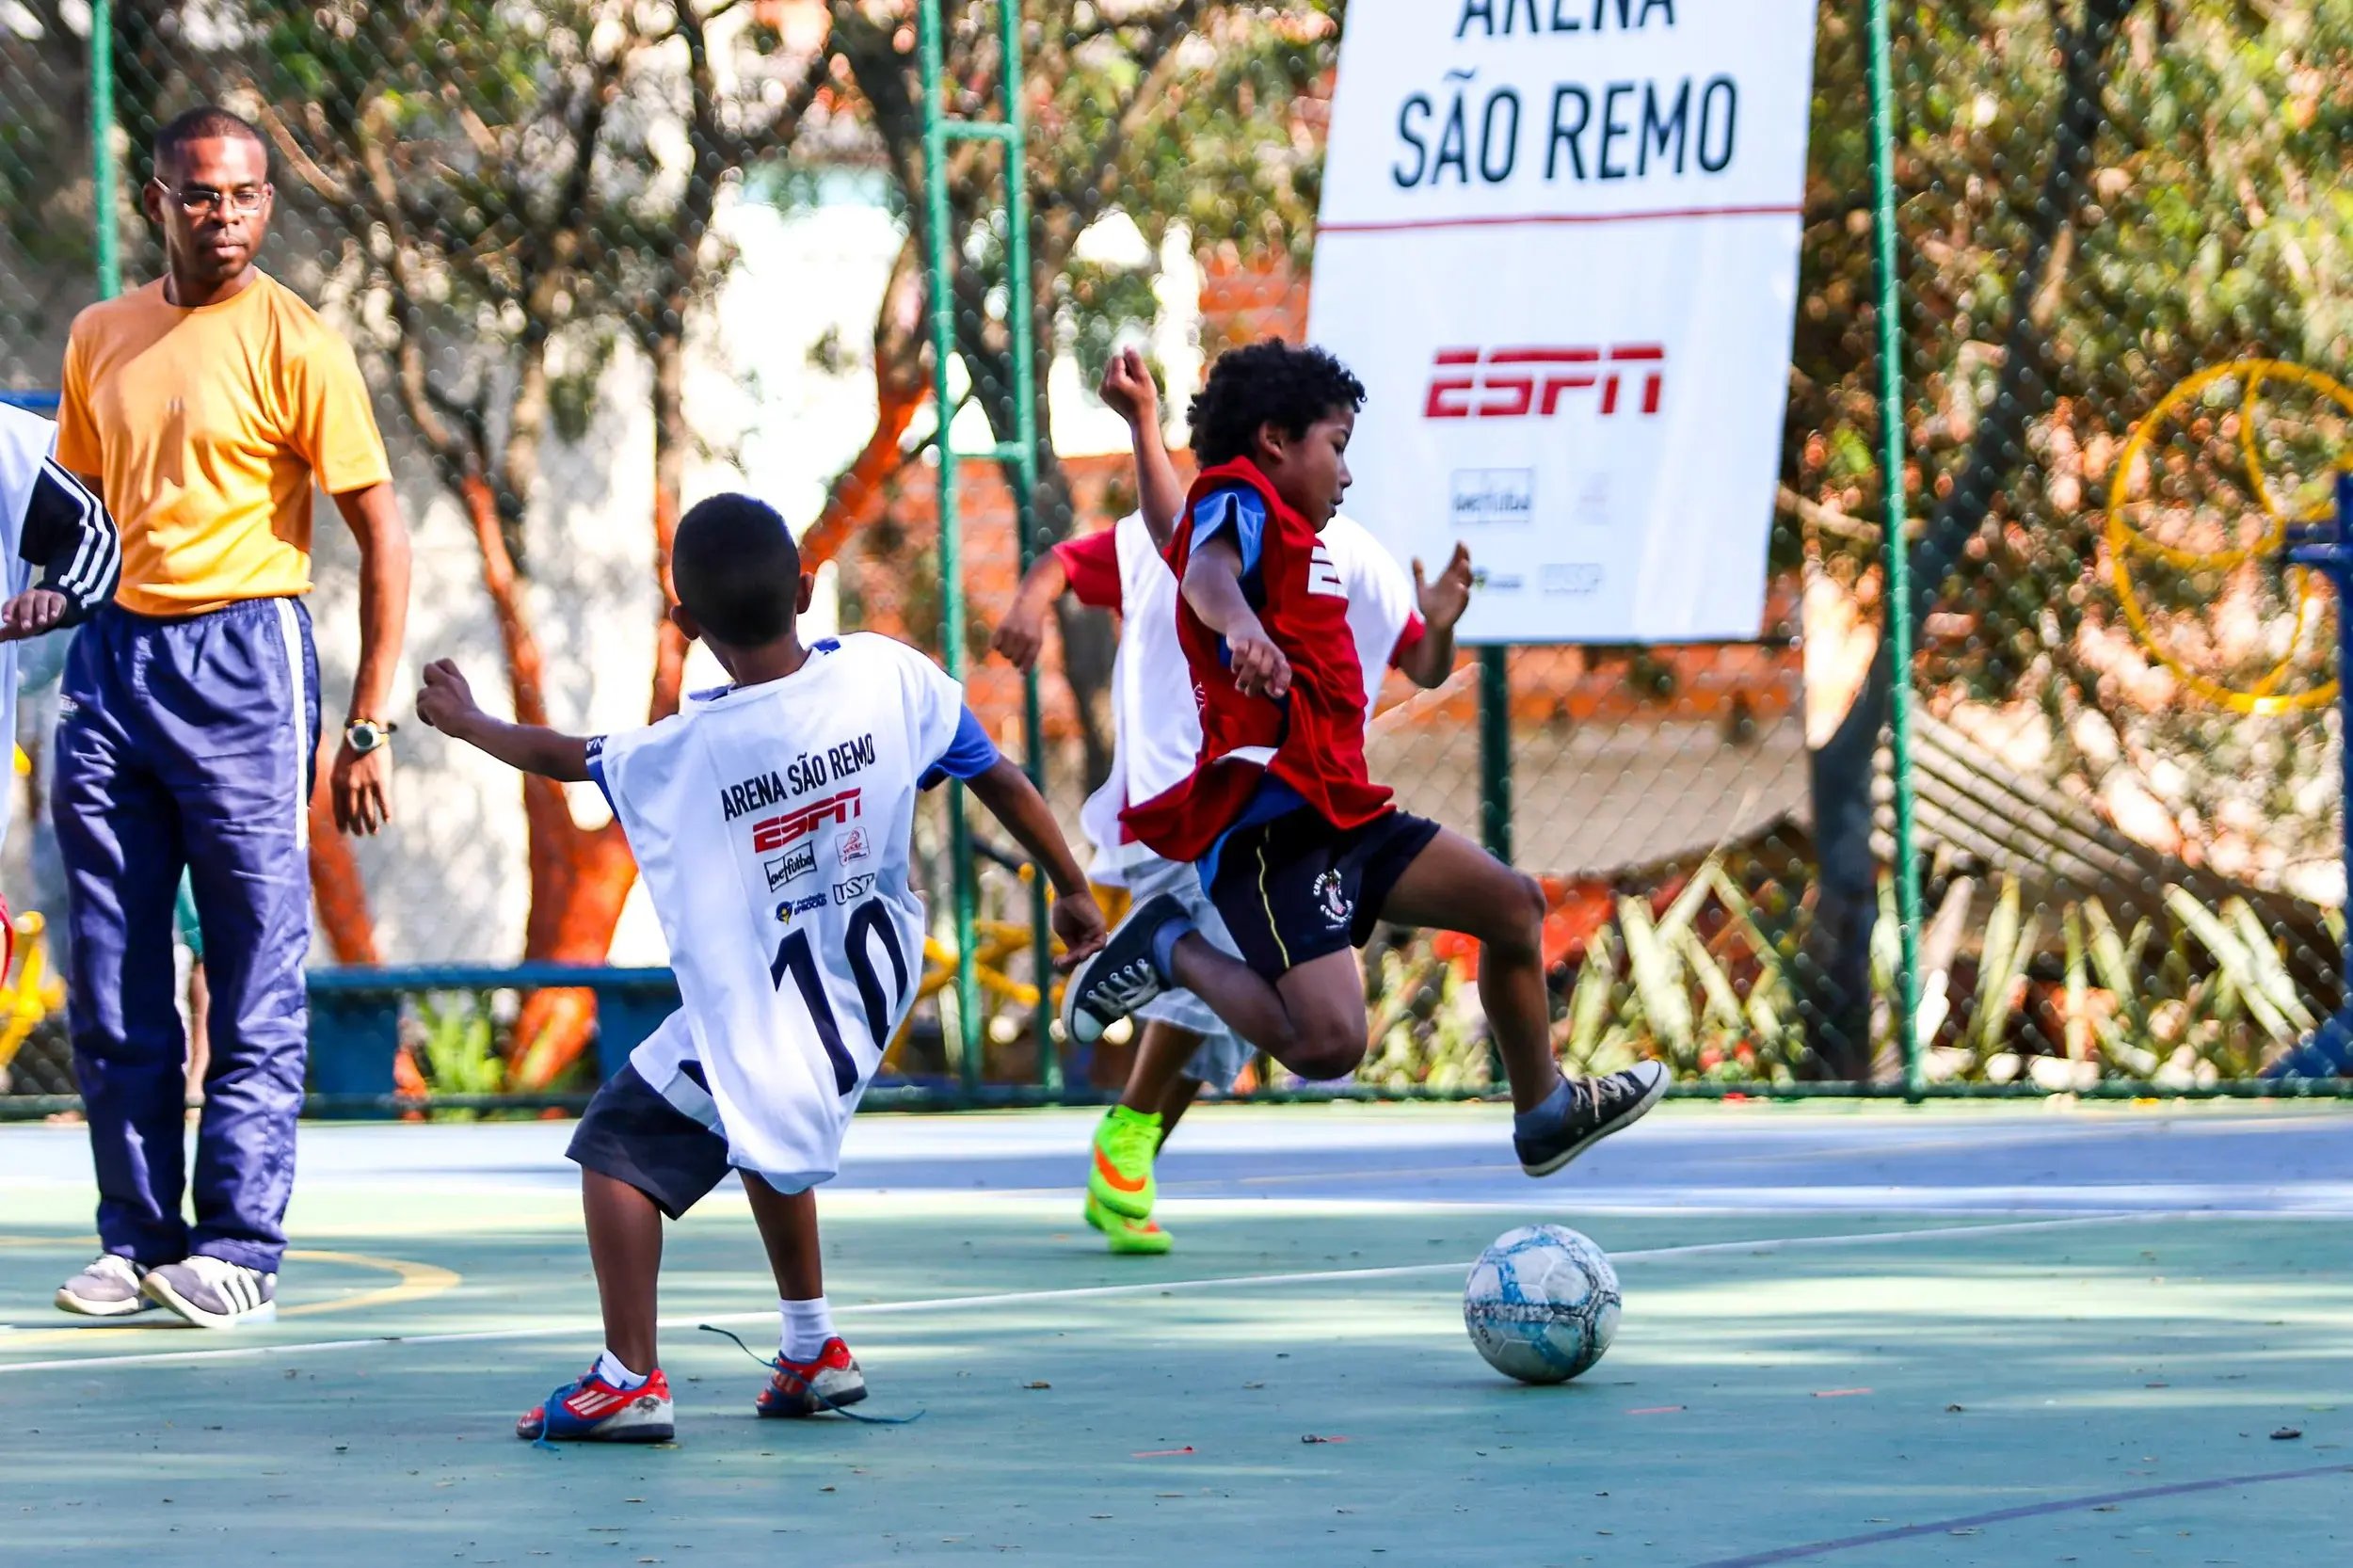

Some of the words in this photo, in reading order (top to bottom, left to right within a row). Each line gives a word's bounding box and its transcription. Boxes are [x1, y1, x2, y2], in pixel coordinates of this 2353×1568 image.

[1394, 68, 1521, 187] SÃO
[1546, 74, 1738, 180] REMO
[1424, 346, 1663, 416] ESPN
[721, 771, 788, 821] ARENA
[788, 752, 827, 795] SÃO
[827, 733, 875, 780] REMO
[753, 788, 860, 853] ESPN
[770, 896, 908, 1096] 10
